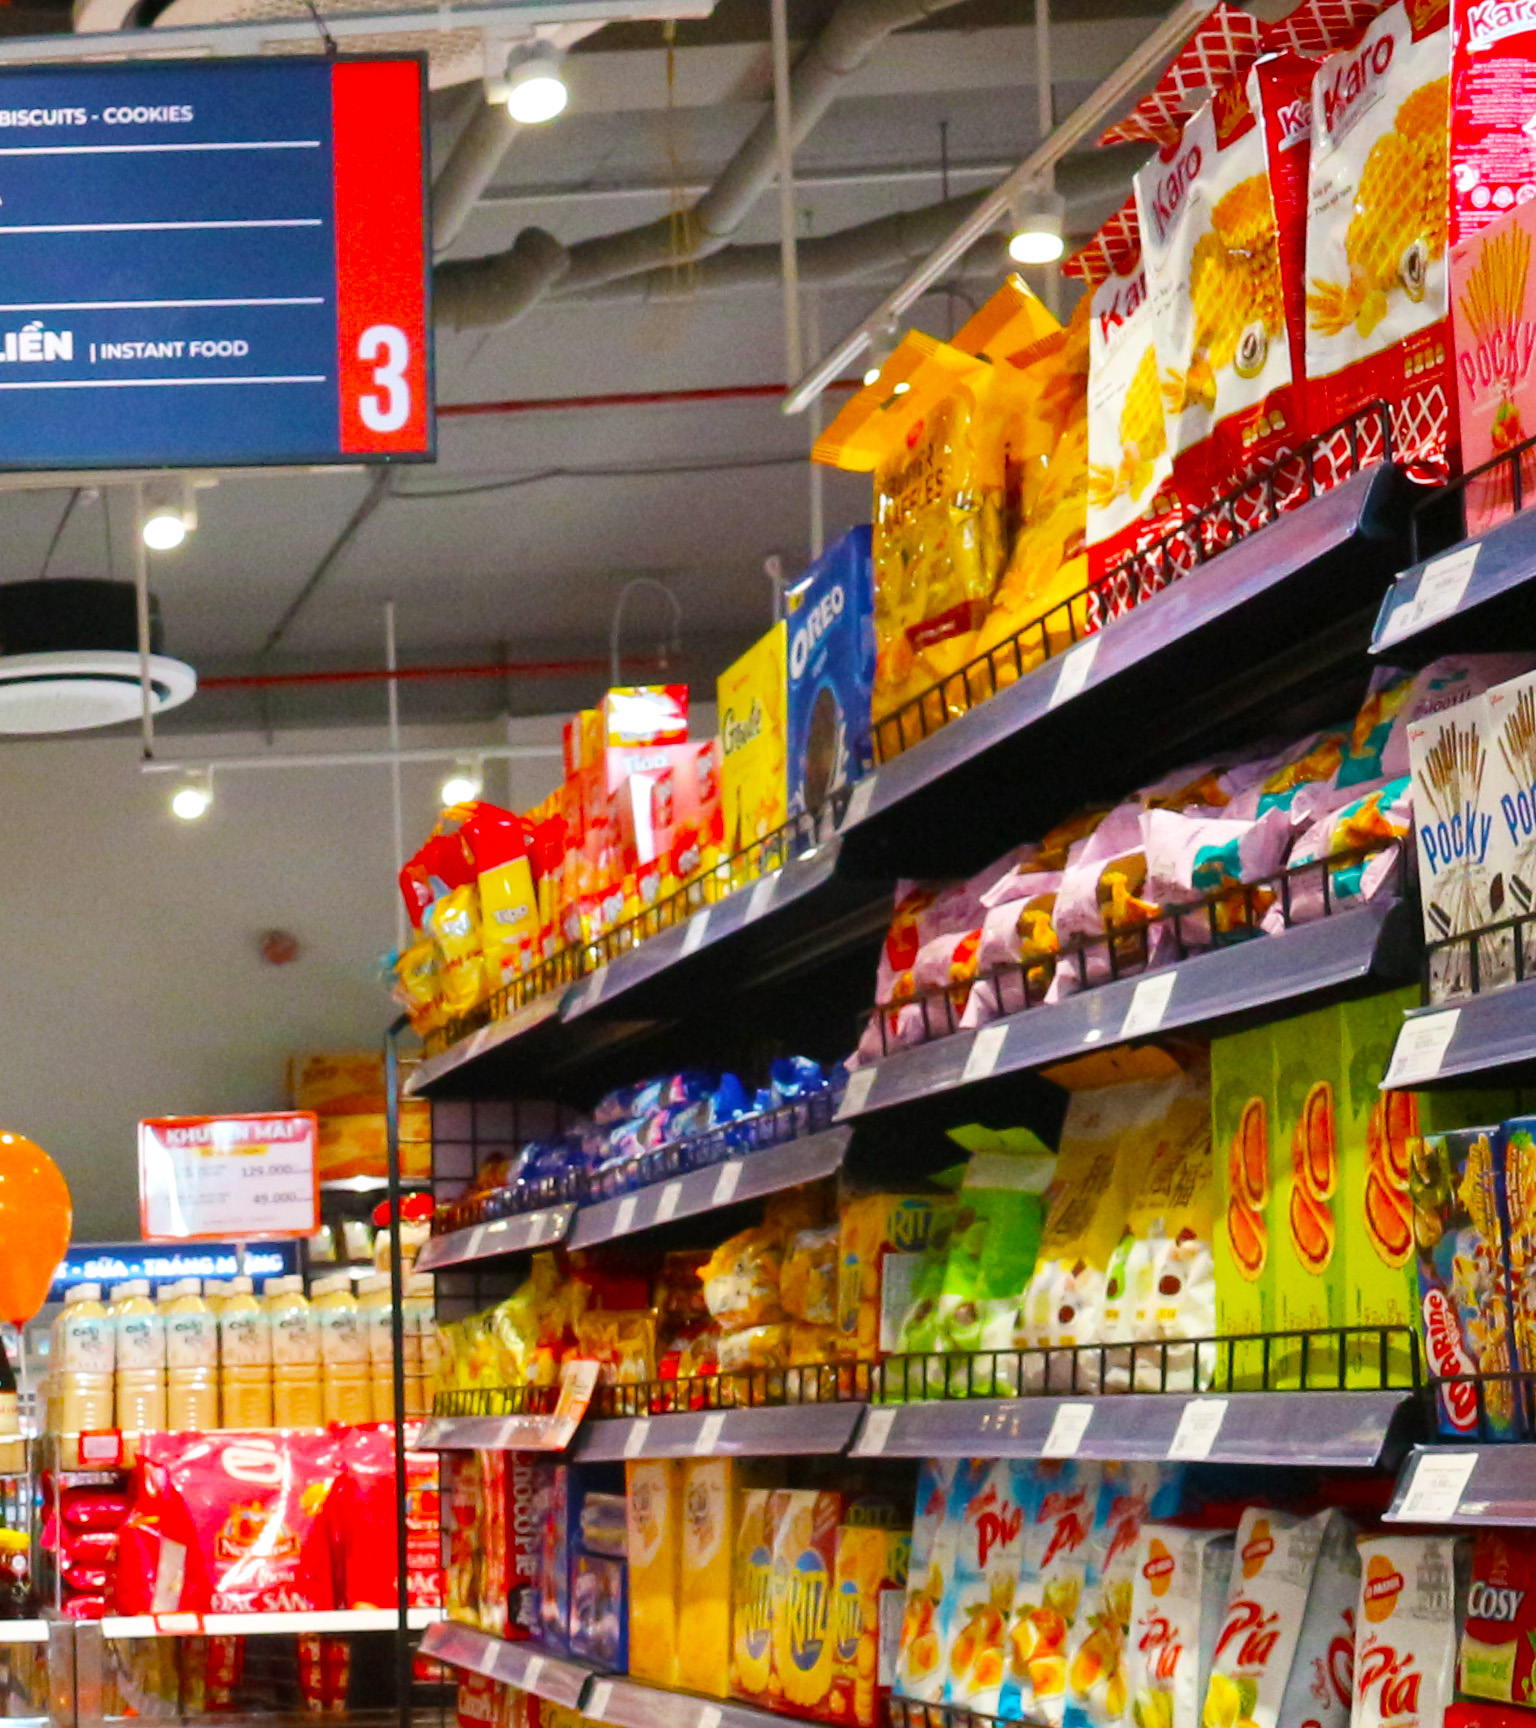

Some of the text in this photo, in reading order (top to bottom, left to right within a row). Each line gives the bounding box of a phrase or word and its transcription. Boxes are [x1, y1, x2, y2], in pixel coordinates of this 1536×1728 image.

[104, 105, 193, 124] COOKIES
[1323, 33, 1394, 130] Karo
[1152, 145, 1202, 235] Karo
[100, 340, 184, 360] INSTANT
[190, 340, 249, 359] FOOD
[357, 325, 413, 432] 3
[790, 586, 844, 680] OREO
[1213, 1599, 1281, 1666] Pía
[1467, 1581, 1524, 1622] COSY
[1360, 1645, 1423, 1718] Pía
